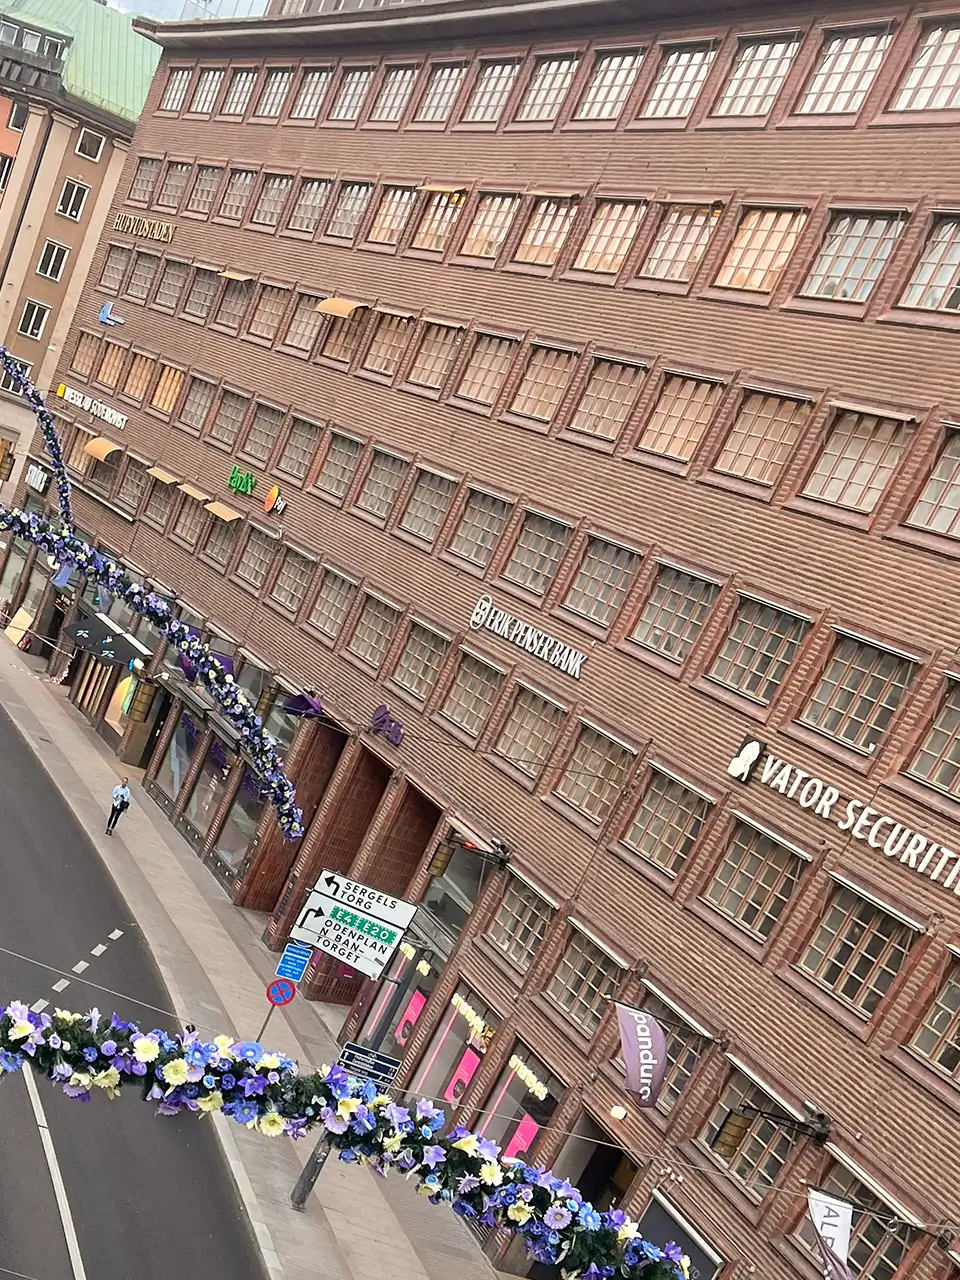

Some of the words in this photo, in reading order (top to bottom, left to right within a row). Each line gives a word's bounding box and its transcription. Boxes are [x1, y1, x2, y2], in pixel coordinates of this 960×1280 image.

[273, 495, 288, 515] Pay
[484, 606, 515, 639] ERIK
[508, 618, 554, 661] PENSER
[548, 641, 589, 679] BANK
[760, 754, 840, 819] VATOR
[837, 799, 960, 897] SECURITI
[340, 890, 372, 910] TORG
[344, 882, 398, 909] SERGELS
[324, 919, 388, 955] ODENPLAN
[335, 910, 352, 923] E4
[362, 925, 390, 940] E20
[316, 935, 361, 964] TORGET
[319, 927, 329, 936] N
[334, 934, 365, 954] BAN-
